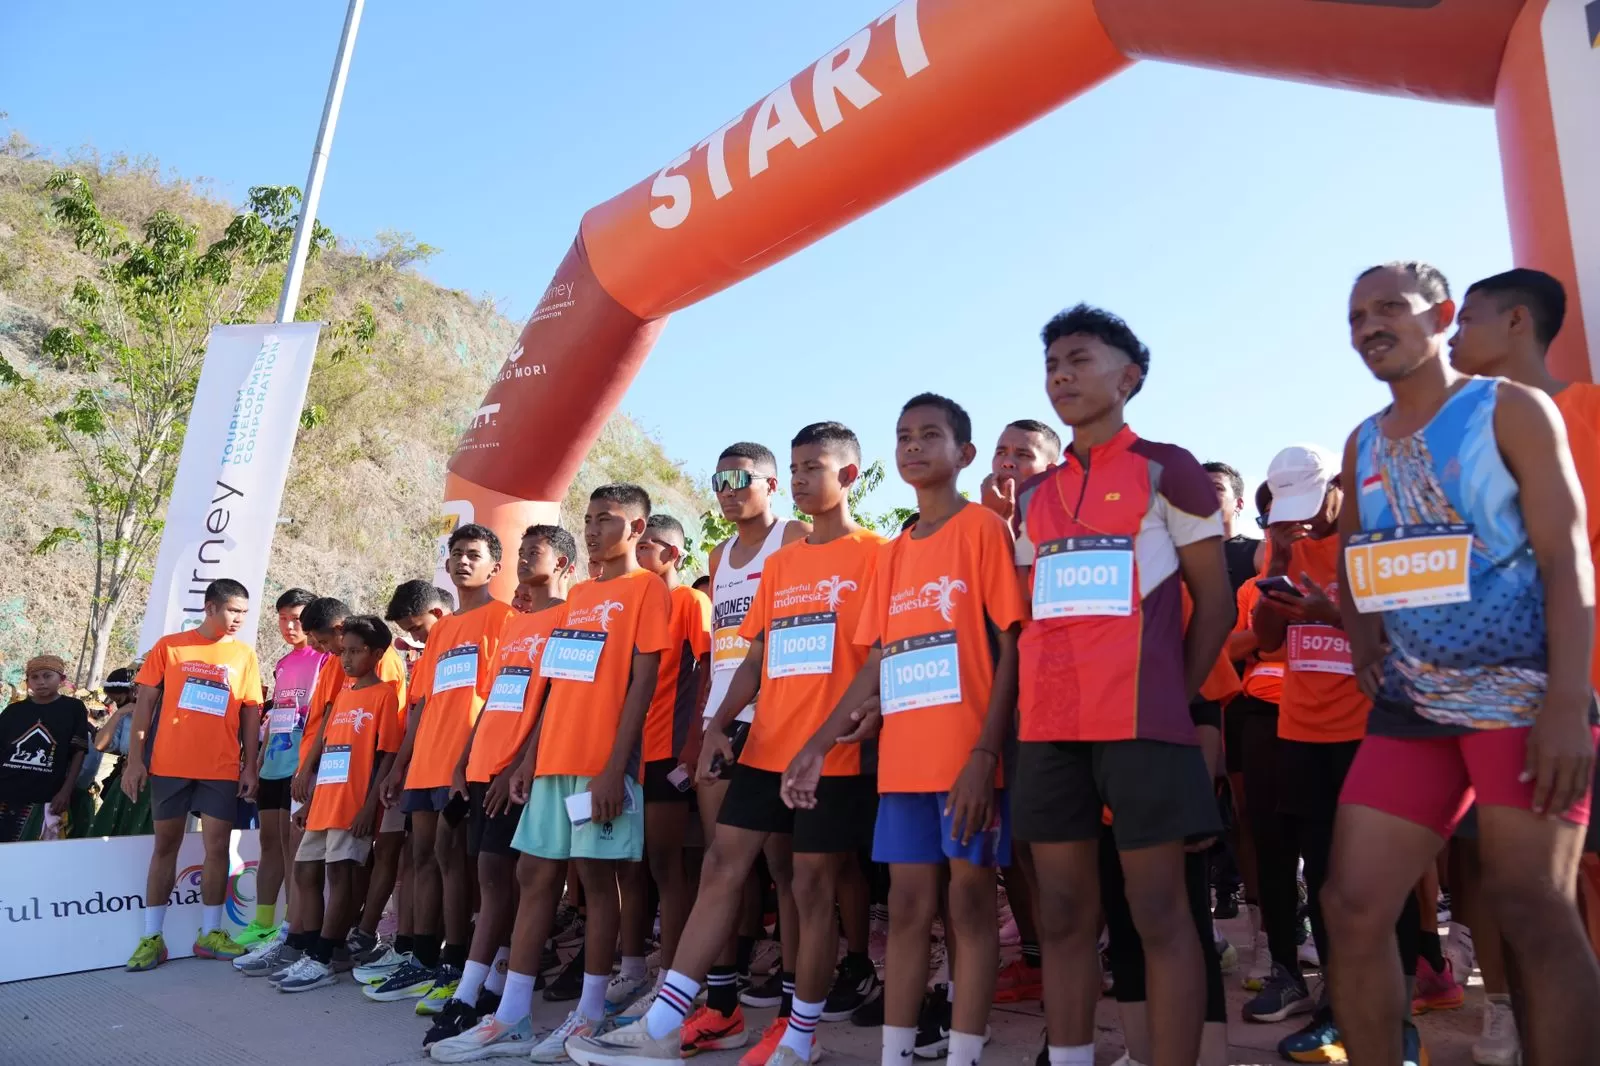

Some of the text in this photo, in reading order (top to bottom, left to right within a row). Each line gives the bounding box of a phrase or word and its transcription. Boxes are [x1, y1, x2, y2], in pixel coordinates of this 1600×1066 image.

[649, 0, 930, 229] START
[515, 363, 547, 379] MORI
[233, 342, 269, 465] DEVELOPMENT
[244, 341, 281, 464] CORPORATION
[221, 388, 245, 466] TOURISM
[1055, 564, 1120, 589] 10001
[1376, 549, 1458, 580] 30501
[773, 592, 822, 609] indonesia
[774, 583, 811, 597] wonderful
[783, 636, 827, 655] 10003
[443, 662, 471, 677] 10159
[896, 659, 951, 686] 10002
[196, 690, 225, 705] 10051
[0, 887, 201, 923] ul indonia
